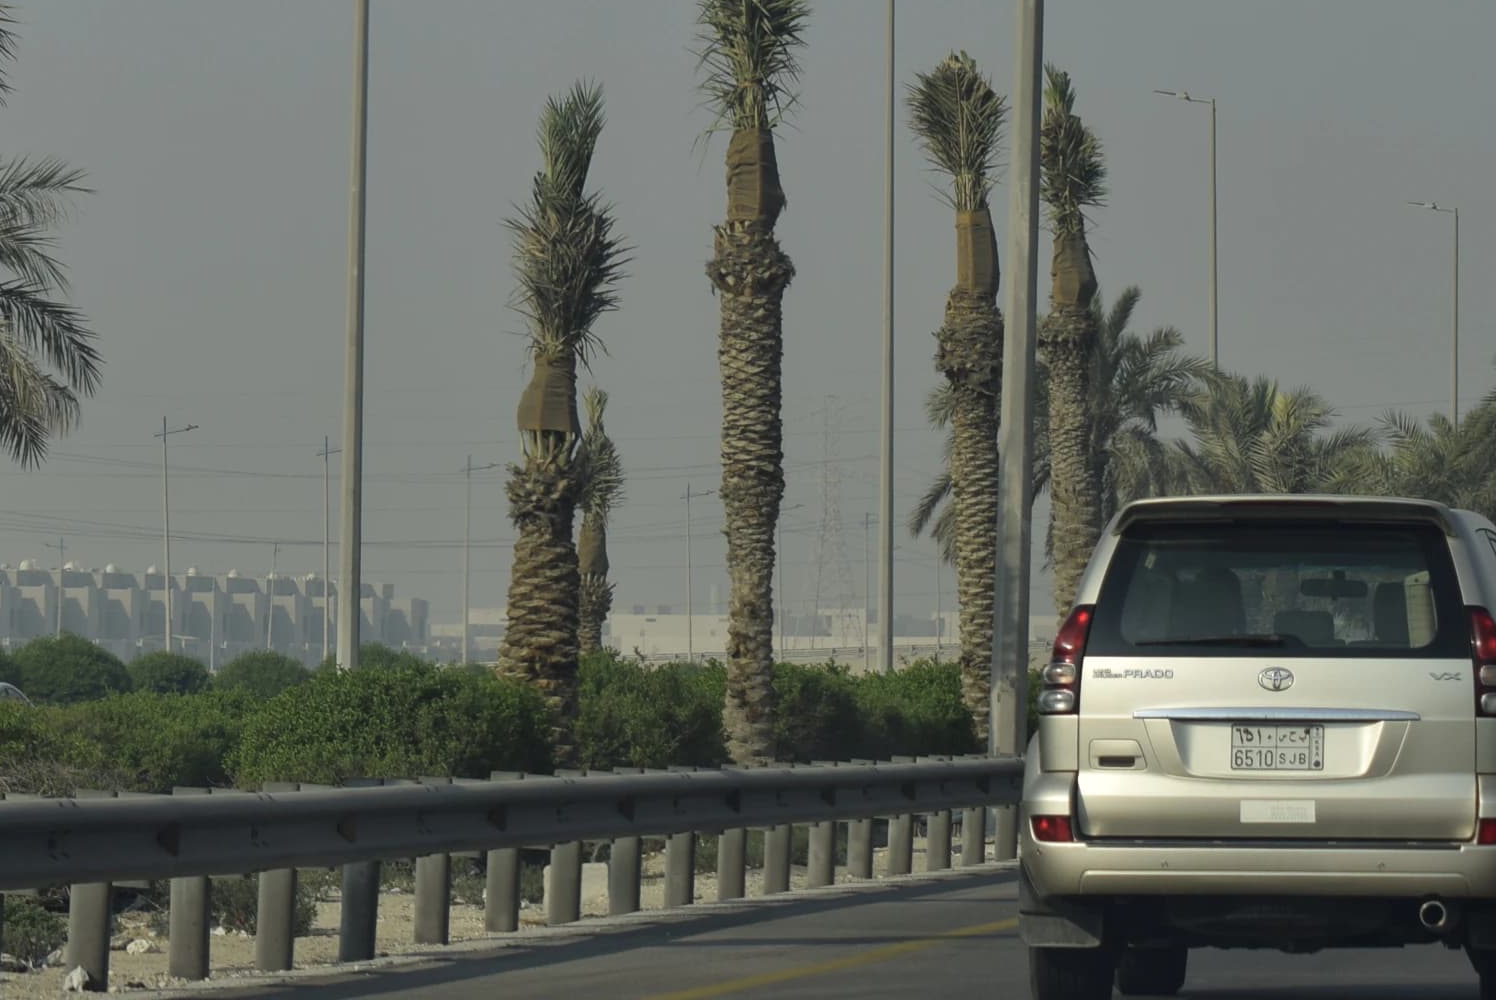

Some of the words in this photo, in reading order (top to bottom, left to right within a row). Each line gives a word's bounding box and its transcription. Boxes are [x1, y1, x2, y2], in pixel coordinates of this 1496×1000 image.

[1123, 669, 1174, 679] PRADO
[1428, 672, 1461, 681] VX
[1234, 749, 1273, 767] 6510
